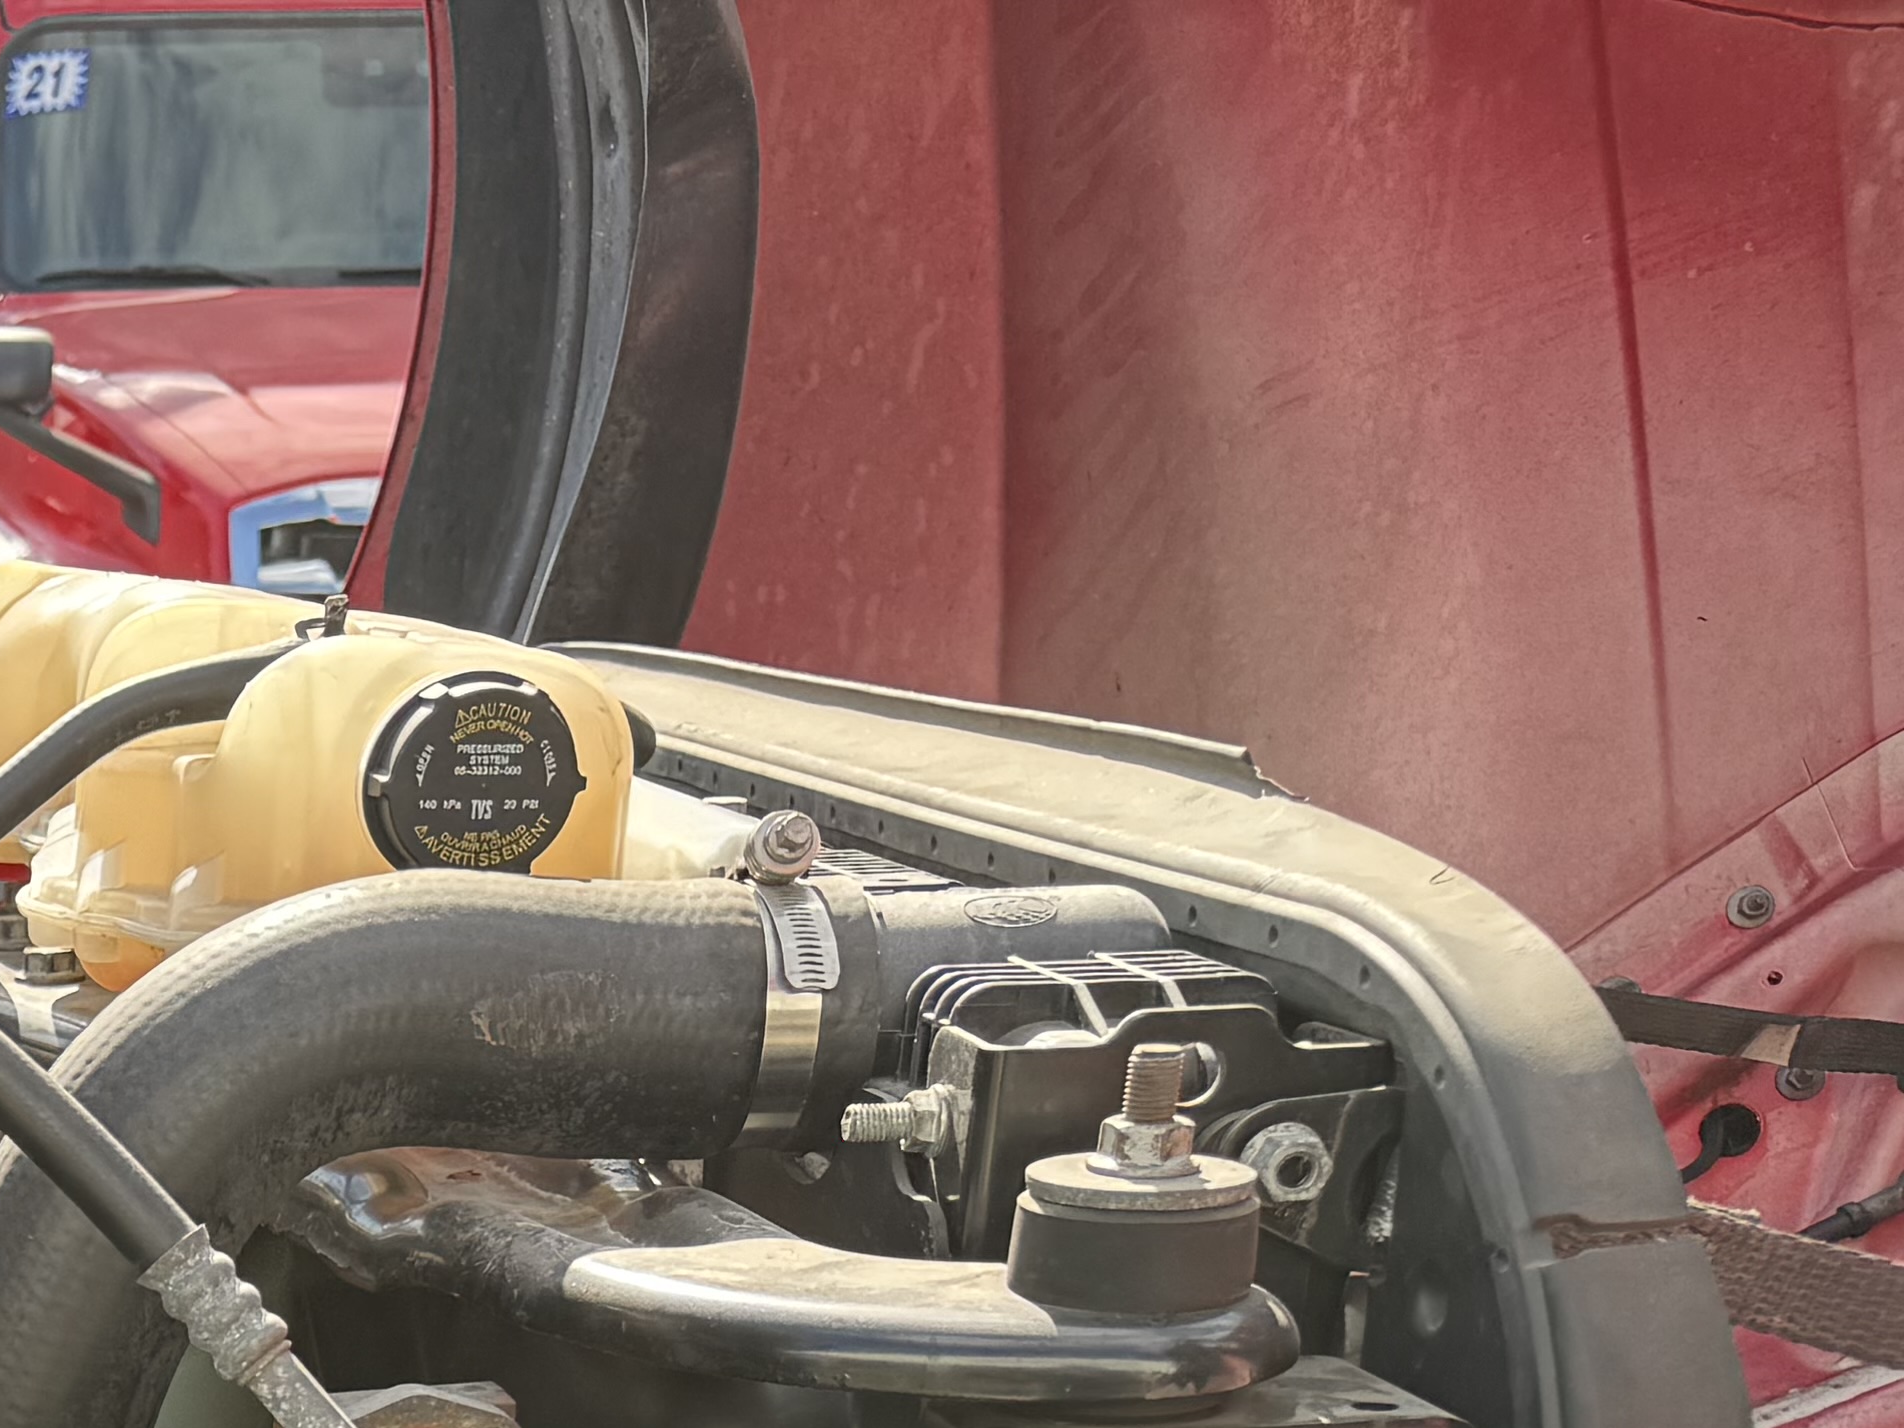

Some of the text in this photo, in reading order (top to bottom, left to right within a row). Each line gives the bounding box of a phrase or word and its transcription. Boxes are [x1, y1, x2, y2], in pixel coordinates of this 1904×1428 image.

[22, 62, 76, 103] 21
[470, 702, 531, 724] CAUTION
[449, 720, 534, 745] NEVER OPEN HOT
[416, 744, 435, 771] OPEN
[457, 744, 524, 754] PRESSURIZED
[469, 755, 509, 765] SYSTEM
[419, 799, 437, 809] 140
[471, 799, 493, 820] TVS
[504, 800, 517, 810] 20
[422, 813, 551, 866] AVERTISSEMENT
[490, 824, 527, 850] CHAUD
